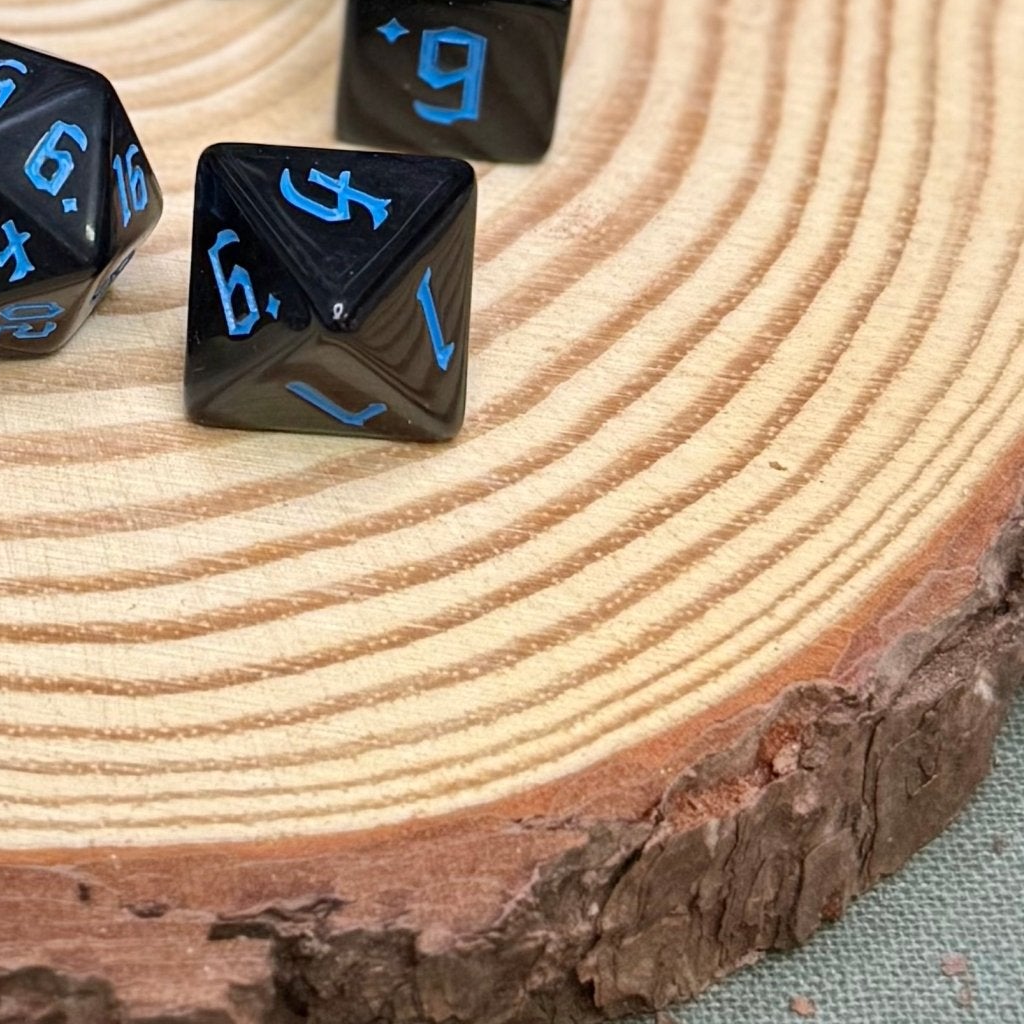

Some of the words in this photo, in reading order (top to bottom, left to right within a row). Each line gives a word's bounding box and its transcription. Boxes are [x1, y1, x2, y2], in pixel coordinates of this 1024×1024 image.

[112, 143, 149, 227] 16
[279, 168, 392, 231] 4
[415, 267, 455, 372] 1
